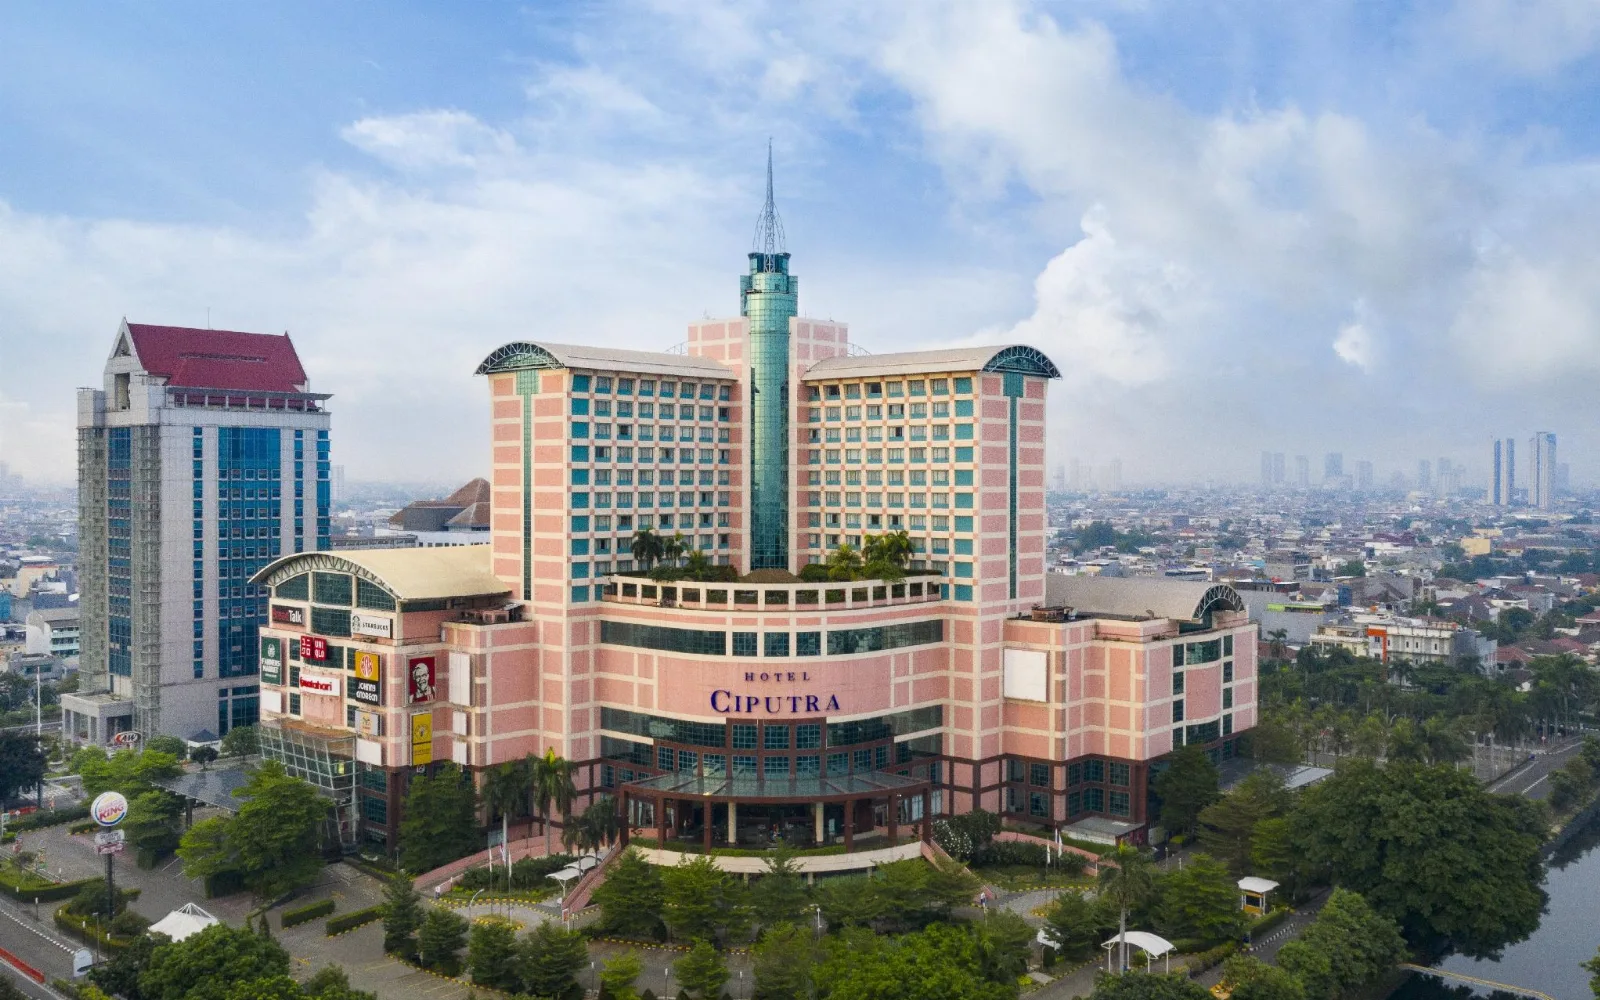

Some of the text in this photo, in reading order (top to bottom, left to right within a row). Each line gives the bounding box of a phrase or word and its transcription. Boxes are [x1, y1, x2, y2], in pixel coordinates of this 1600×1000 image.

[362, 622, 389, 631] STARBUCKS
[744, 672, 811, 682] HOTEL
[710, 689, 841, 714] CIPUTRA
[99, 806, 124, 820] KING
